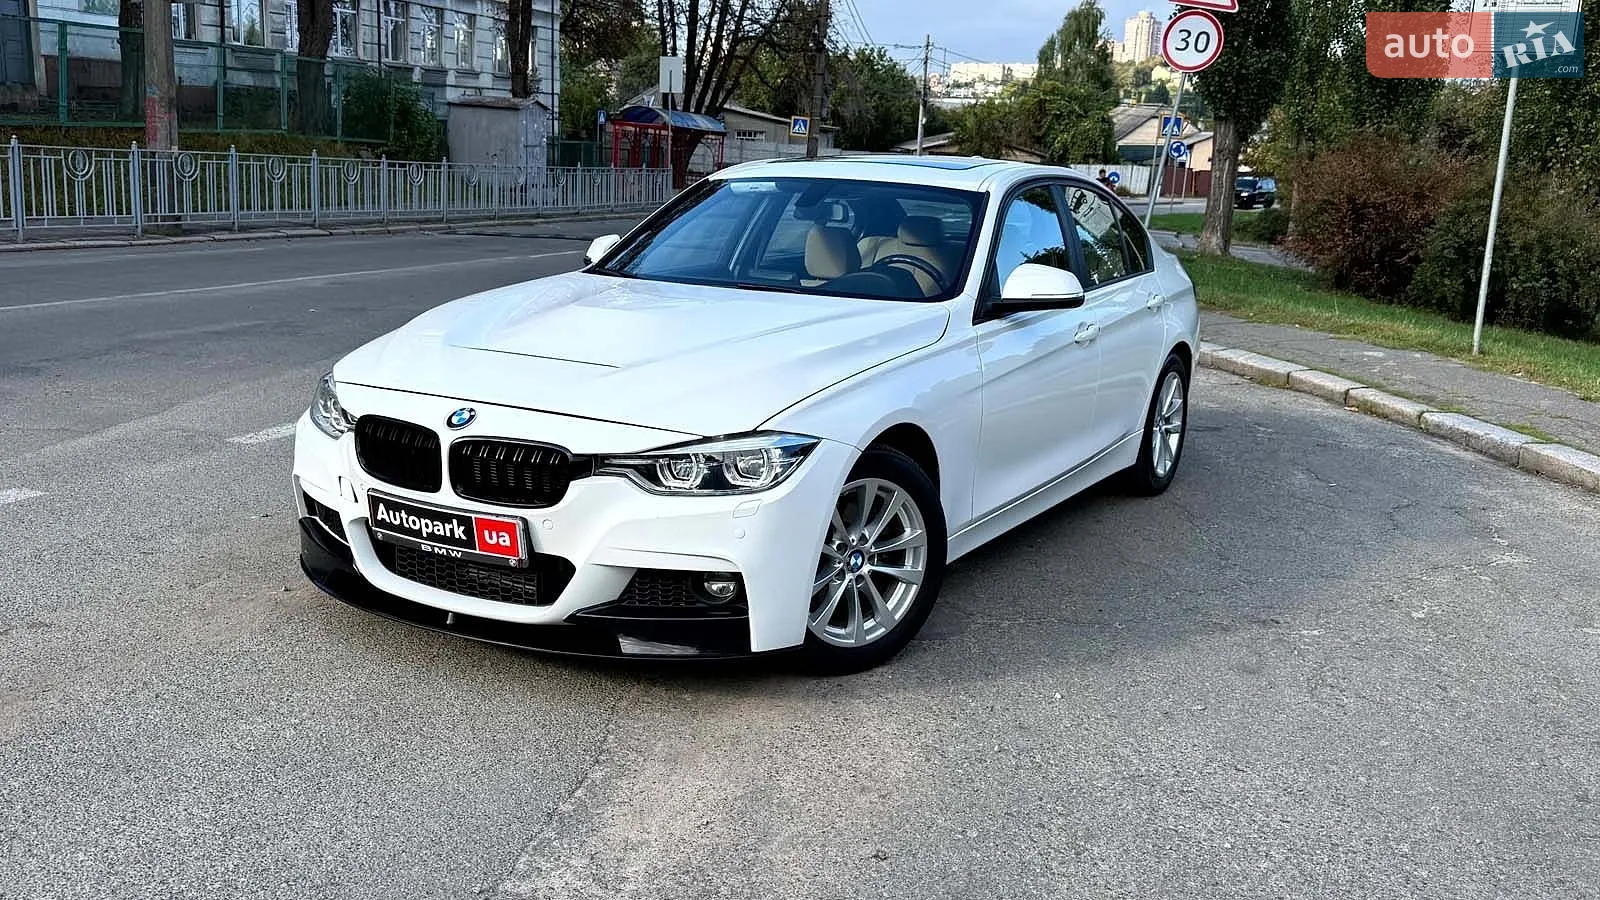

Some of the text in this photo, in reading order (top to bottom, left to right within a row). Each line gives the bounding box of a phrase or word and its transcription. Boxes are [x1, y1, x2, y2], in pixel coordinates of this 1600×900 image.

[1175, 28, 1211, 54] 30
[376, 503, 511, 547] Autopark ua
[421, 543, 462, 559] BMW
